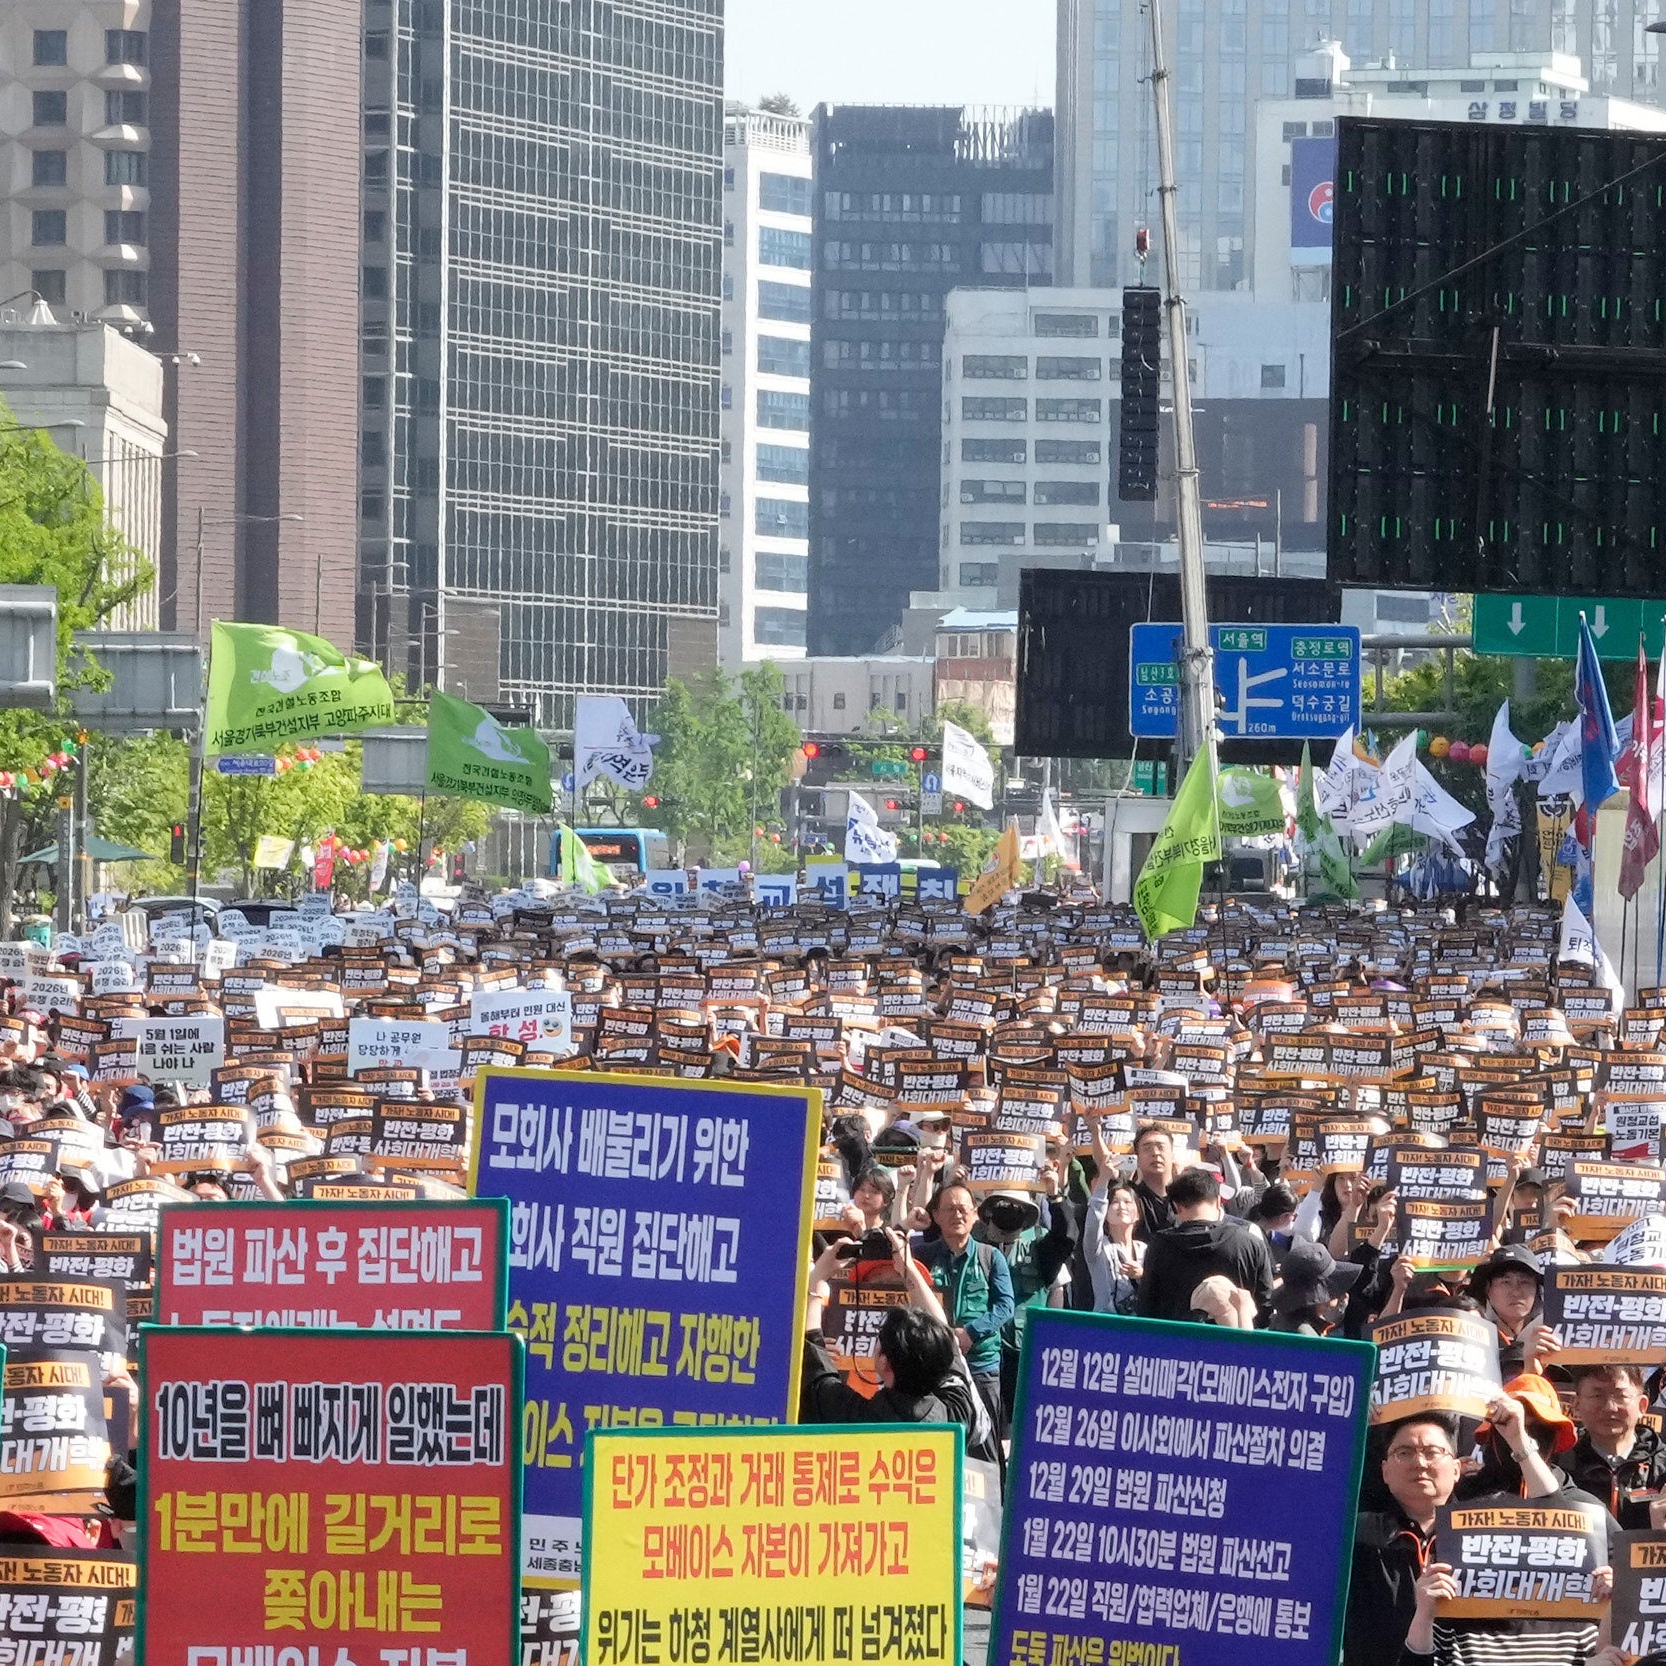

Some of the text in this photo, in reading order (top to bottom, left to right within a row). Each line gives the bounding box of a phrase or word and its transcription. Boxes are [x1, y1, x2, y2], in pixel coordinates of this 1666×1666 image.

[1223, 633, 1264, 648] 서울역
[1293, 662, 1351, 678] 서소문로
[1294, 641, 1350, 656] 충정로역
[1248, 723, 1276, 732] 260m
[1292, 696, 1350, 712] 덕수궁길
[146, 1028, 200, 1041] 5월 1일에
[153, 1058, 194, 1069] 나야 나
[190, 1042, 214, 1054] 사람
[490, 1102, 749, 1187] 모회사 배불리기 위한
[172, 1226, 482, 1286] 법원 파산 후 집단해고
[571, 1205, 740, 1283] 직원 집단해고
[563, 1304, 761, 1386] 정리해고 자행한
[1041, 1347, 1078, 1390] 12월
[1084, 1352, 1120, 1394] 12일
[155, 1379, 250, 1462] 10년을
[290, 1381, 381, 1464] 빠지게
[386, 1381, 504, 1466] 일했는데
[1035, 1404, 1325, 1473] 12월 26일 이사회에서 파산절차 의결
[612, 1447, 937, 1509] 단가 조정과 거래 통제로 수익은
[154, 1491, 502, 1556] 1분만에 길거리로
[597, 1604, 947, 1665] 위기는 하청 계열사에게 떠 넘겨졌다
[1017, 1574, 1043, 1613] 1월
[1046, 1577, 1088, 1617] 22일
[1276, 1596, 1312, 1641] 통보
